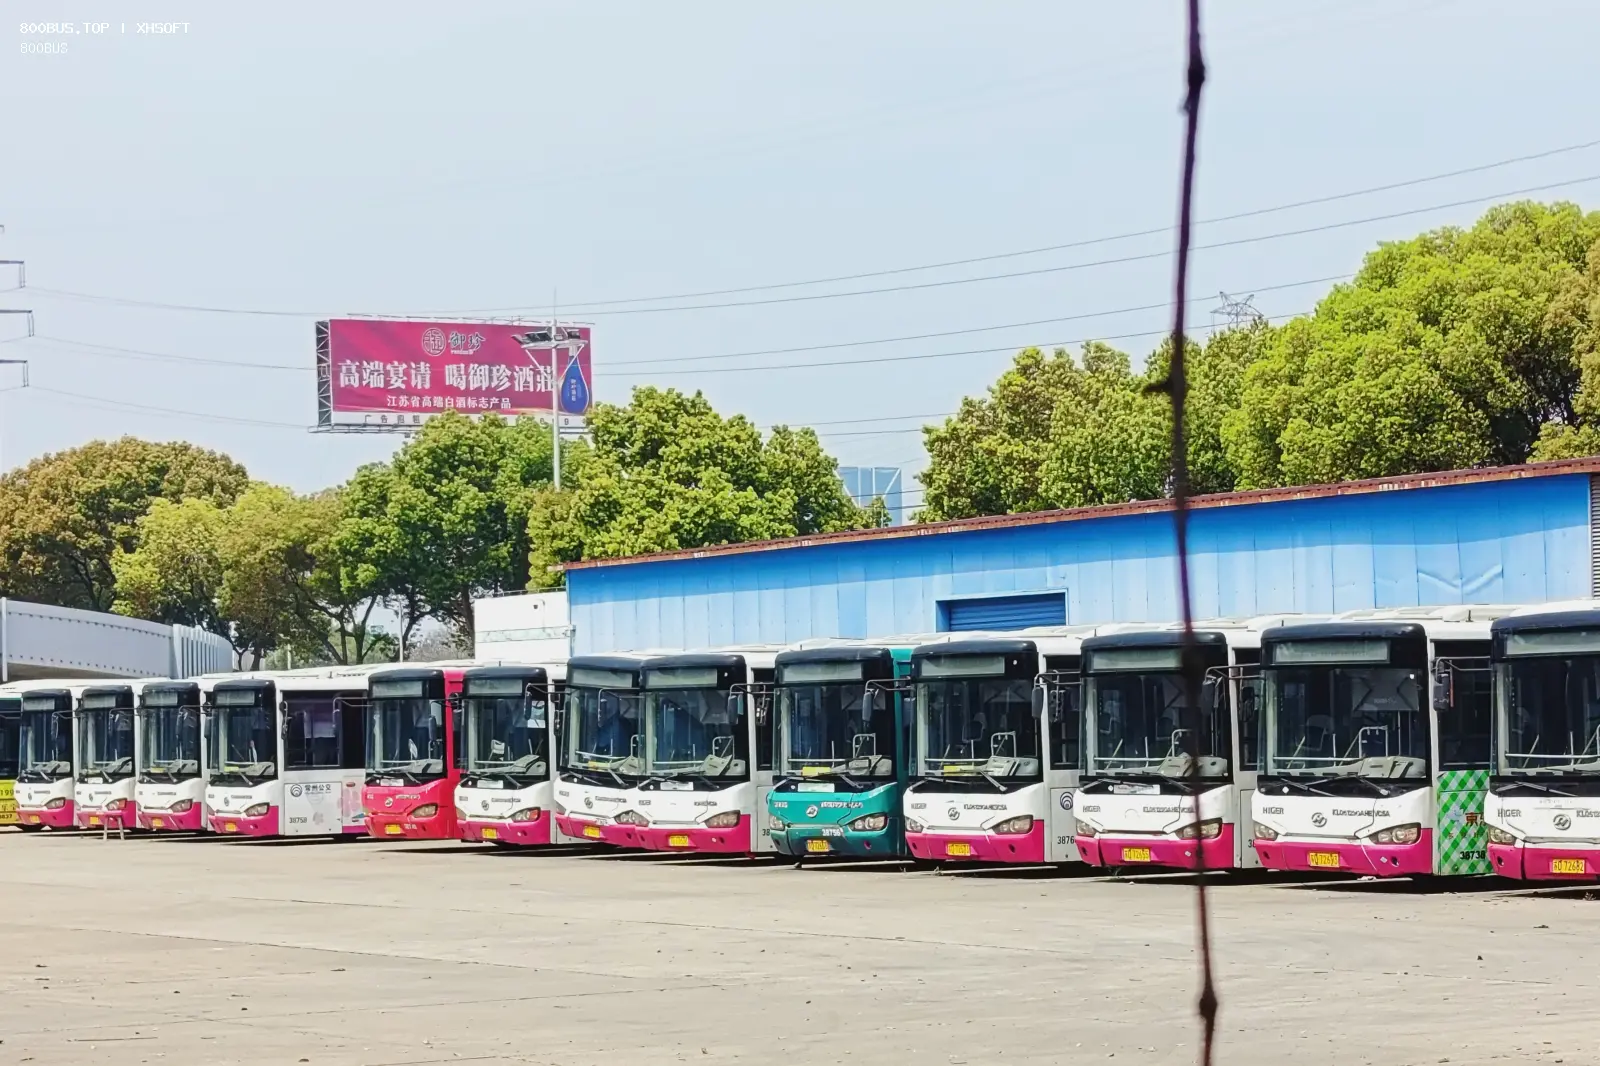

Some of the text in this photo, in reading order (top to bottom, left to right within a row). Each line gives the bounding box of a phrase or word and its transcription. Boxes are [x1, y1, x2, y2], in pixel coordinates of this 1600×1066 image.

[338, 359, 432, 390] 高端宴请
[386, 394, 512, 409] 江苏省高端白酒标志产品
[1262, 806, 1285, 815] HIGER
[1497, 808, 1522, 818] HIGER
